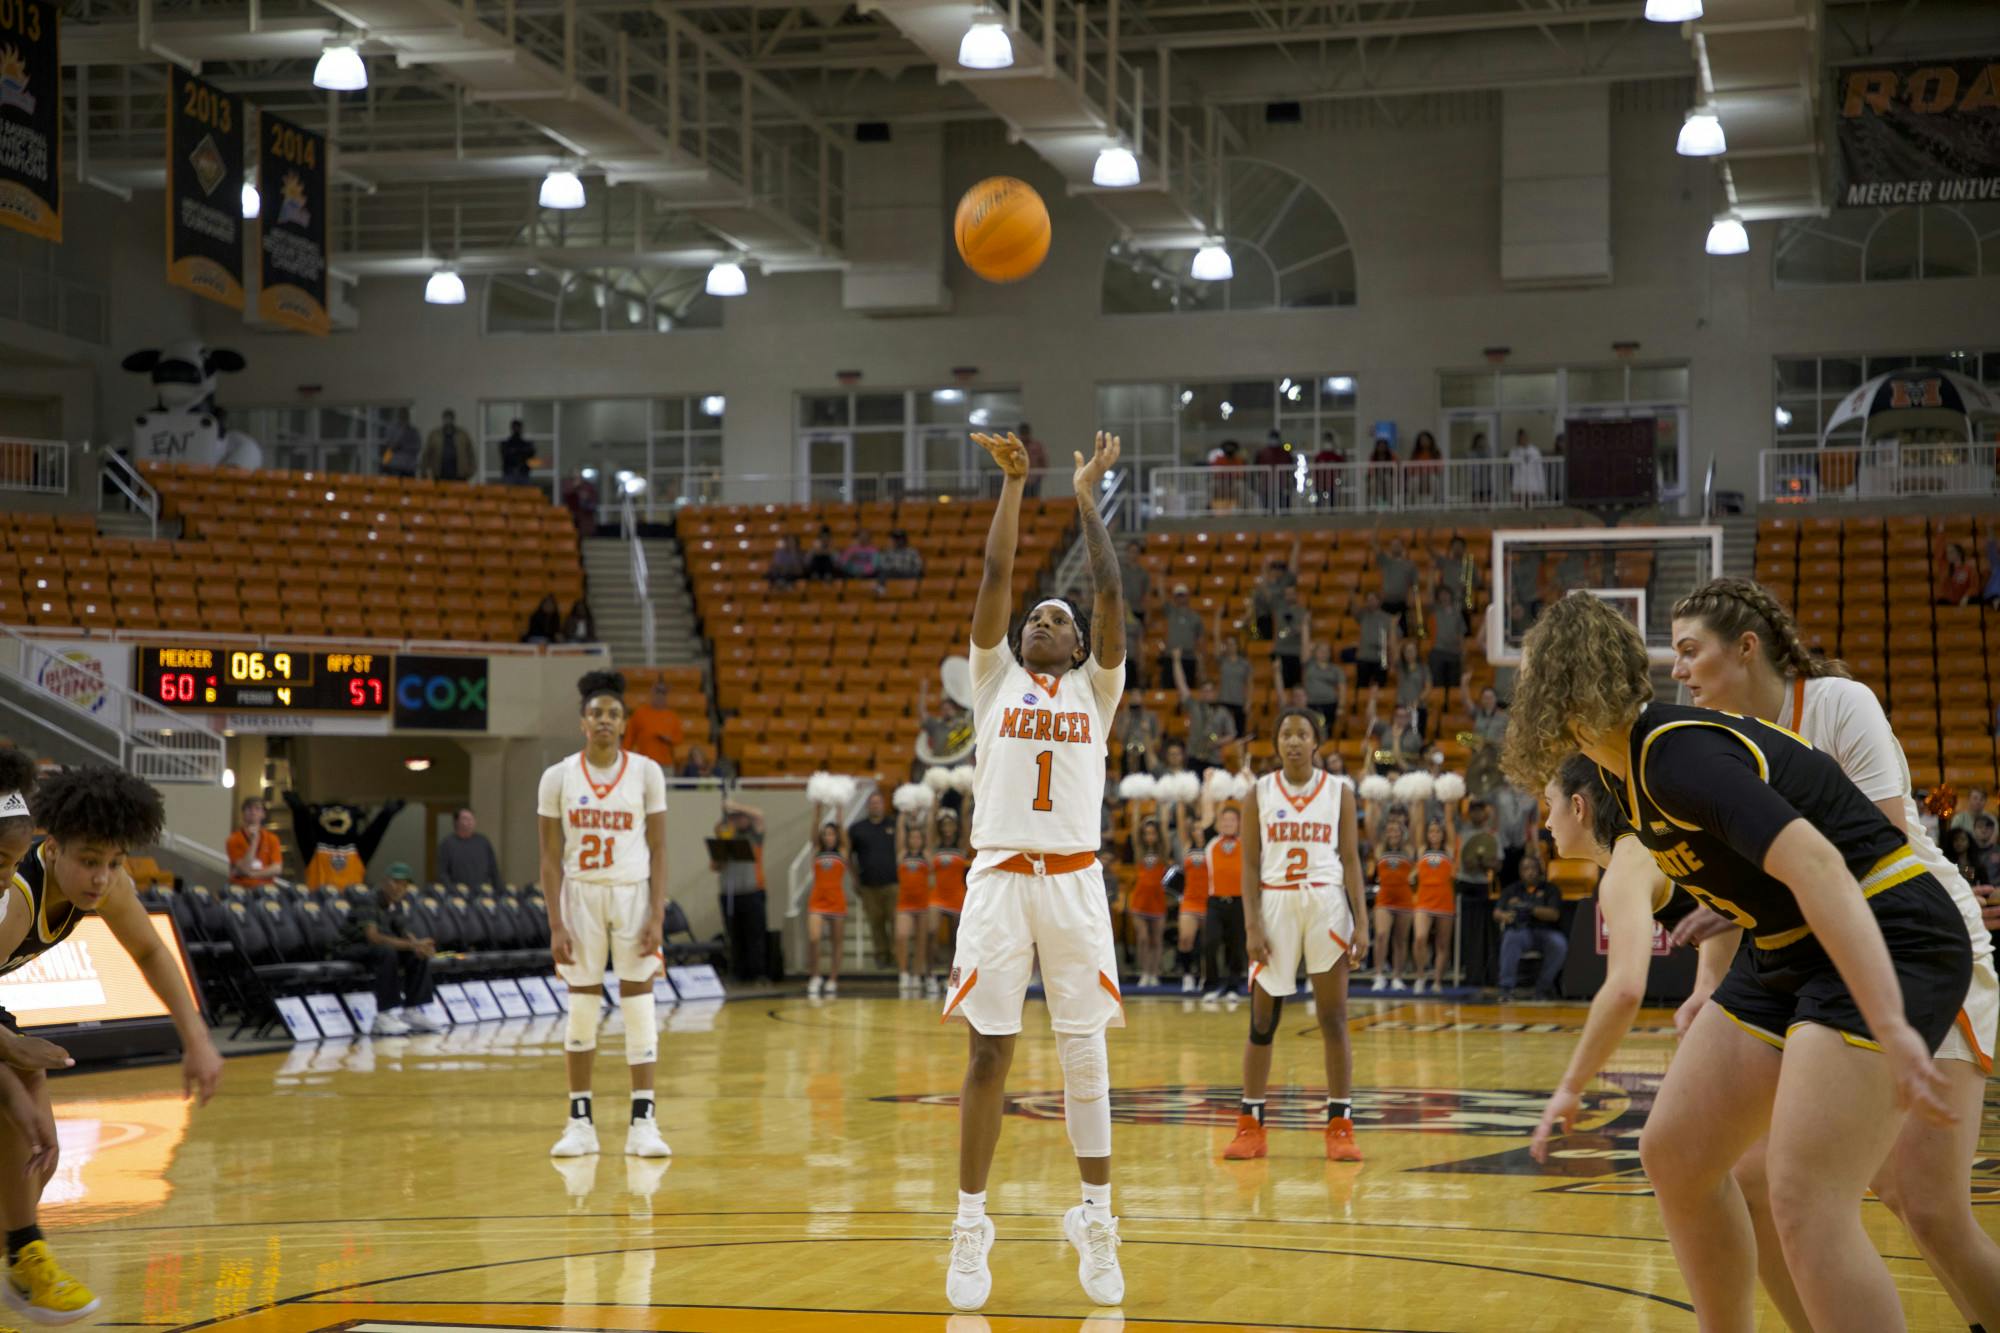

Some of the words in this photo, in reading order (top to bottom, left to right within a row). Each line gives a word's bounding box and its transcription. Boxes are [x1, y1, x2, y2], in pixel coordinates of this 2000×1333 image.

[183, 80, 232, 134] 2013
[270, 123, 316, 170] 2014
[1848, 181, 1933, 205] MERCER
[159, 648, 213, 668] MERCER
[231, 651, 292, 681] 06.9
[160, 673, 195, 702] 60
[350, 678, 382, 707] 57
[277, 687, 291, 707] 4
[397, 673, 486, 711] COX
[998, 707, 1092, 744] MERCER
[1032, 750, 1053, 812] 1
[568, 808, 634, 832] MERCER
[1266, 821, 1332, 844] MERCER
[578, 834, 616, 872] 21
[1285, 847, 1308, 882] 2
